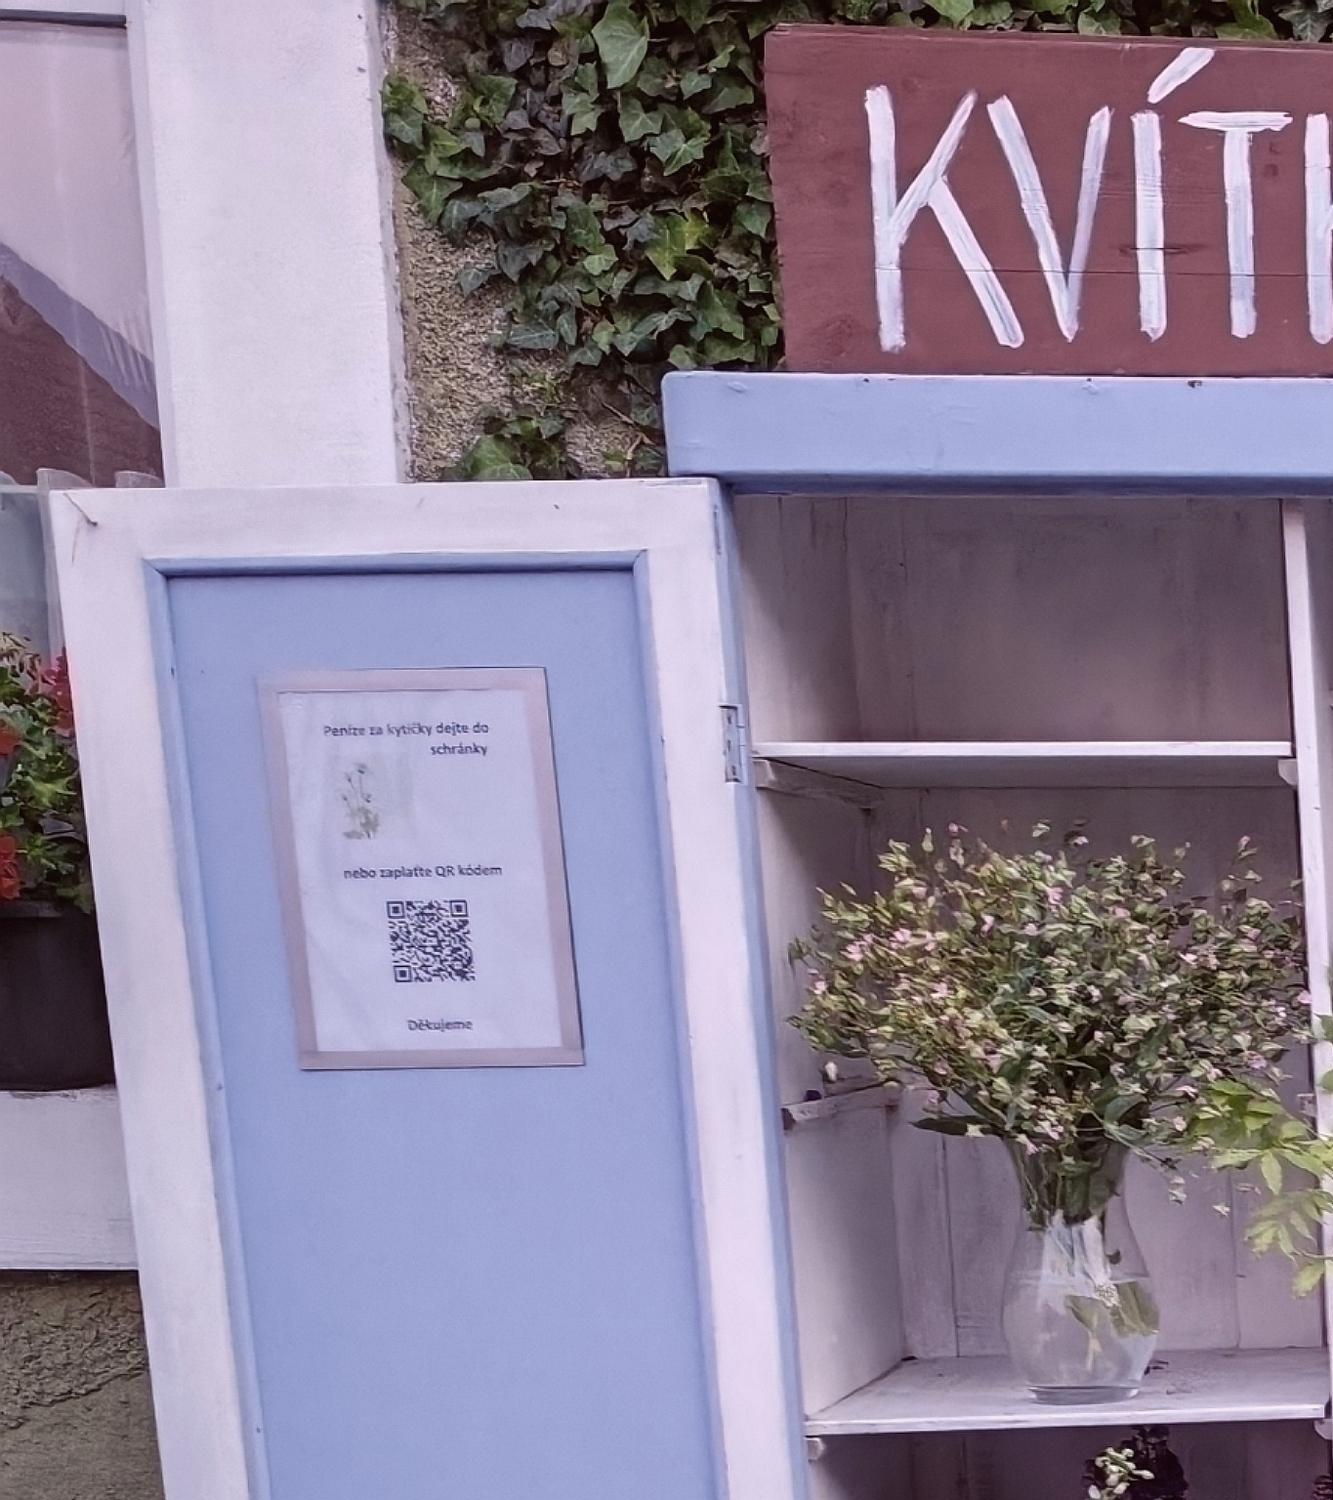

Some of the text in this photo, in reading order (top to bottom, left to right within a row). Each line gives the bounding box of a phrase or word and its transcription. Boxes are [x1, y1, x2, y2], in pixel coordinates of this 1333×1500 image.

[369, 726, 384, 735] za
[436, 722, 469, 736] dejte
[472, 722, 489, 734] do
[430, 742, 488, 756] schránky
[343, 867, 377, 879] nebo
[435, 865, 455, 878] QR
[457, 864, 503, 876] kódem
